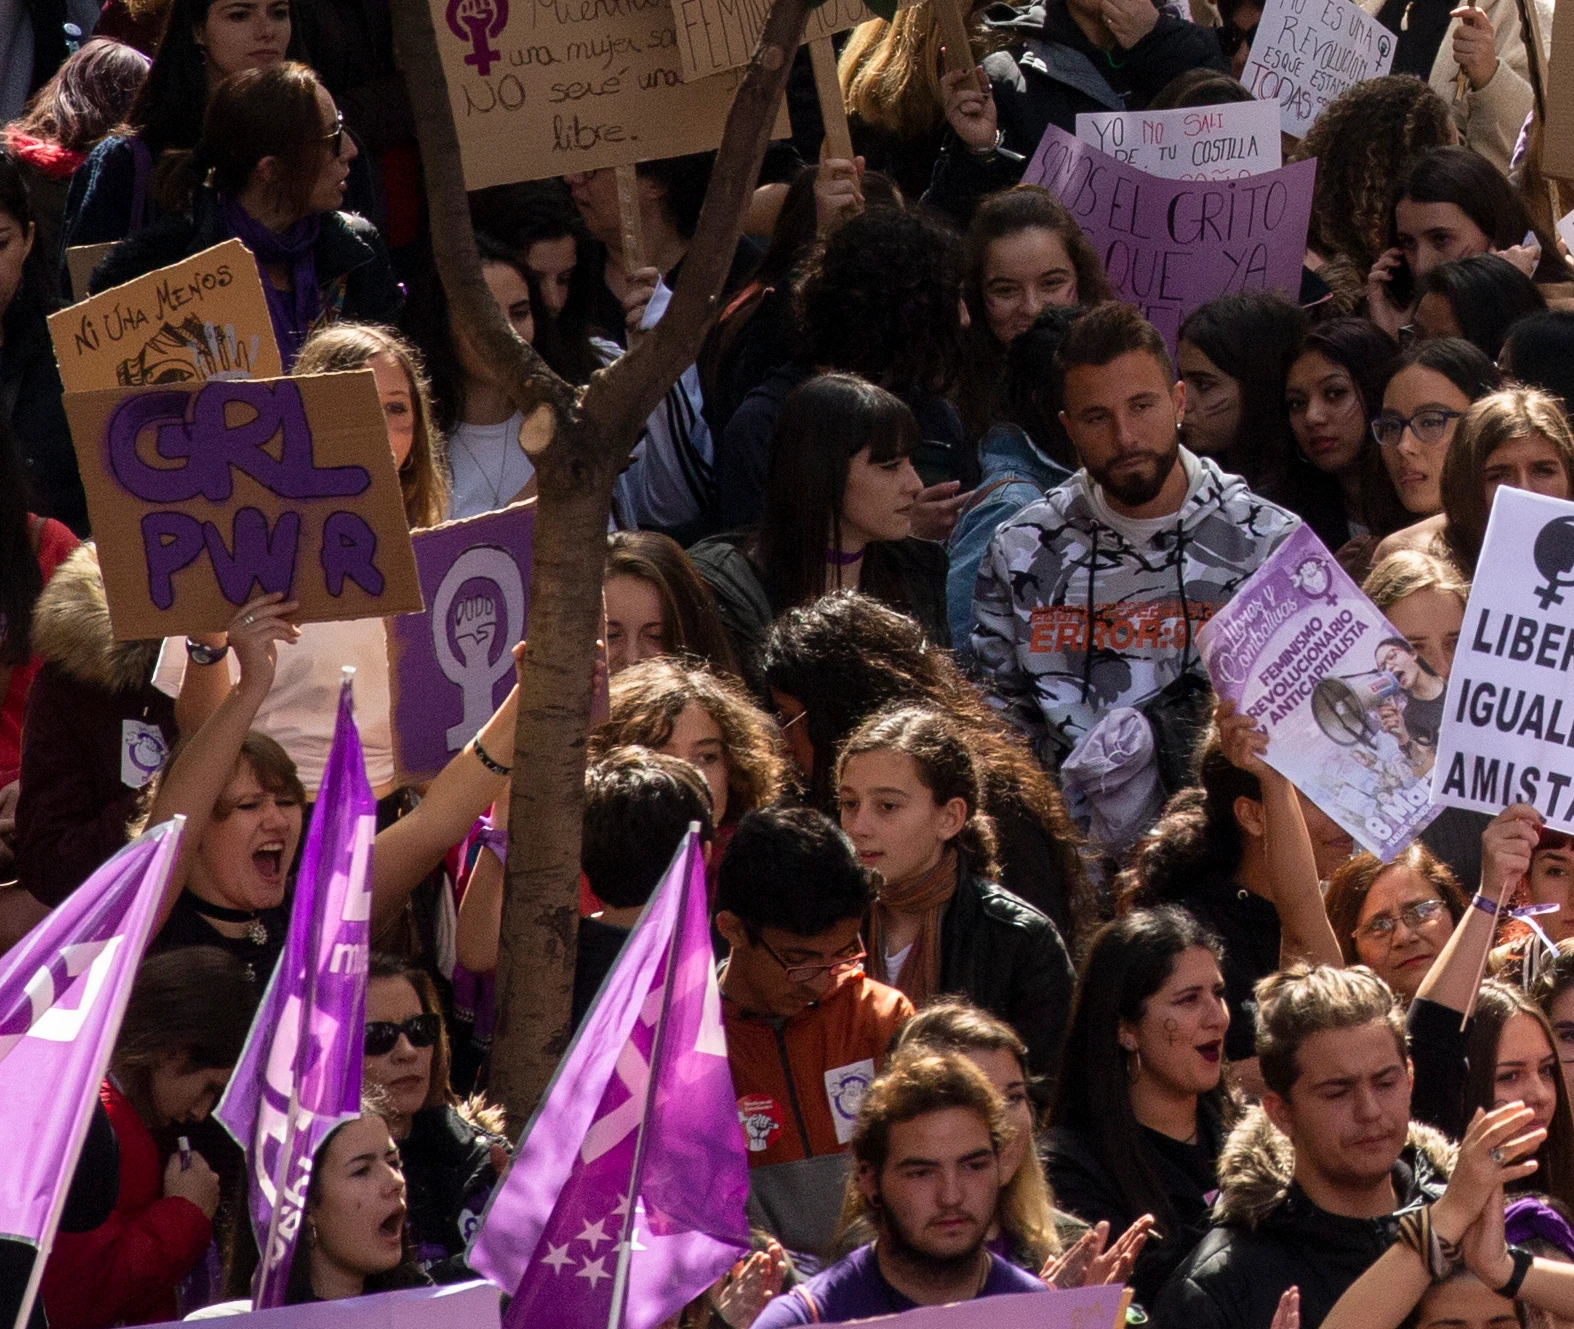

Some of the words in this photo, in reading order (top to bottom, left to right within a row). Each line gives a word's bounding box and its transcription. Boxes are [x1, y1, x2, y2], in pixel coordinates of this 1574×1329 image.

[509, 45, 561, 67] una
[566, 34, 642, 69] mujer
[552, 114, 639, 152] libre.
[1093, 117, 1125, 152] YO
[1143, 120, 1164, 145] NO
[1106, 241, 1193, 303] QUE
[1223, 244, 1269, 296] YA
[107, 376, 373, 504] GRL
[140, 506, 386, 611] PWR
[1245, 608, 1354, 720] REVOLUCIONARIO
[1257, 616, 1324, 689] FEMINISMO
[1268, 620, 1370, 726] ANTICAPITALISTA
[1363, 816, 1393, 842] 8
